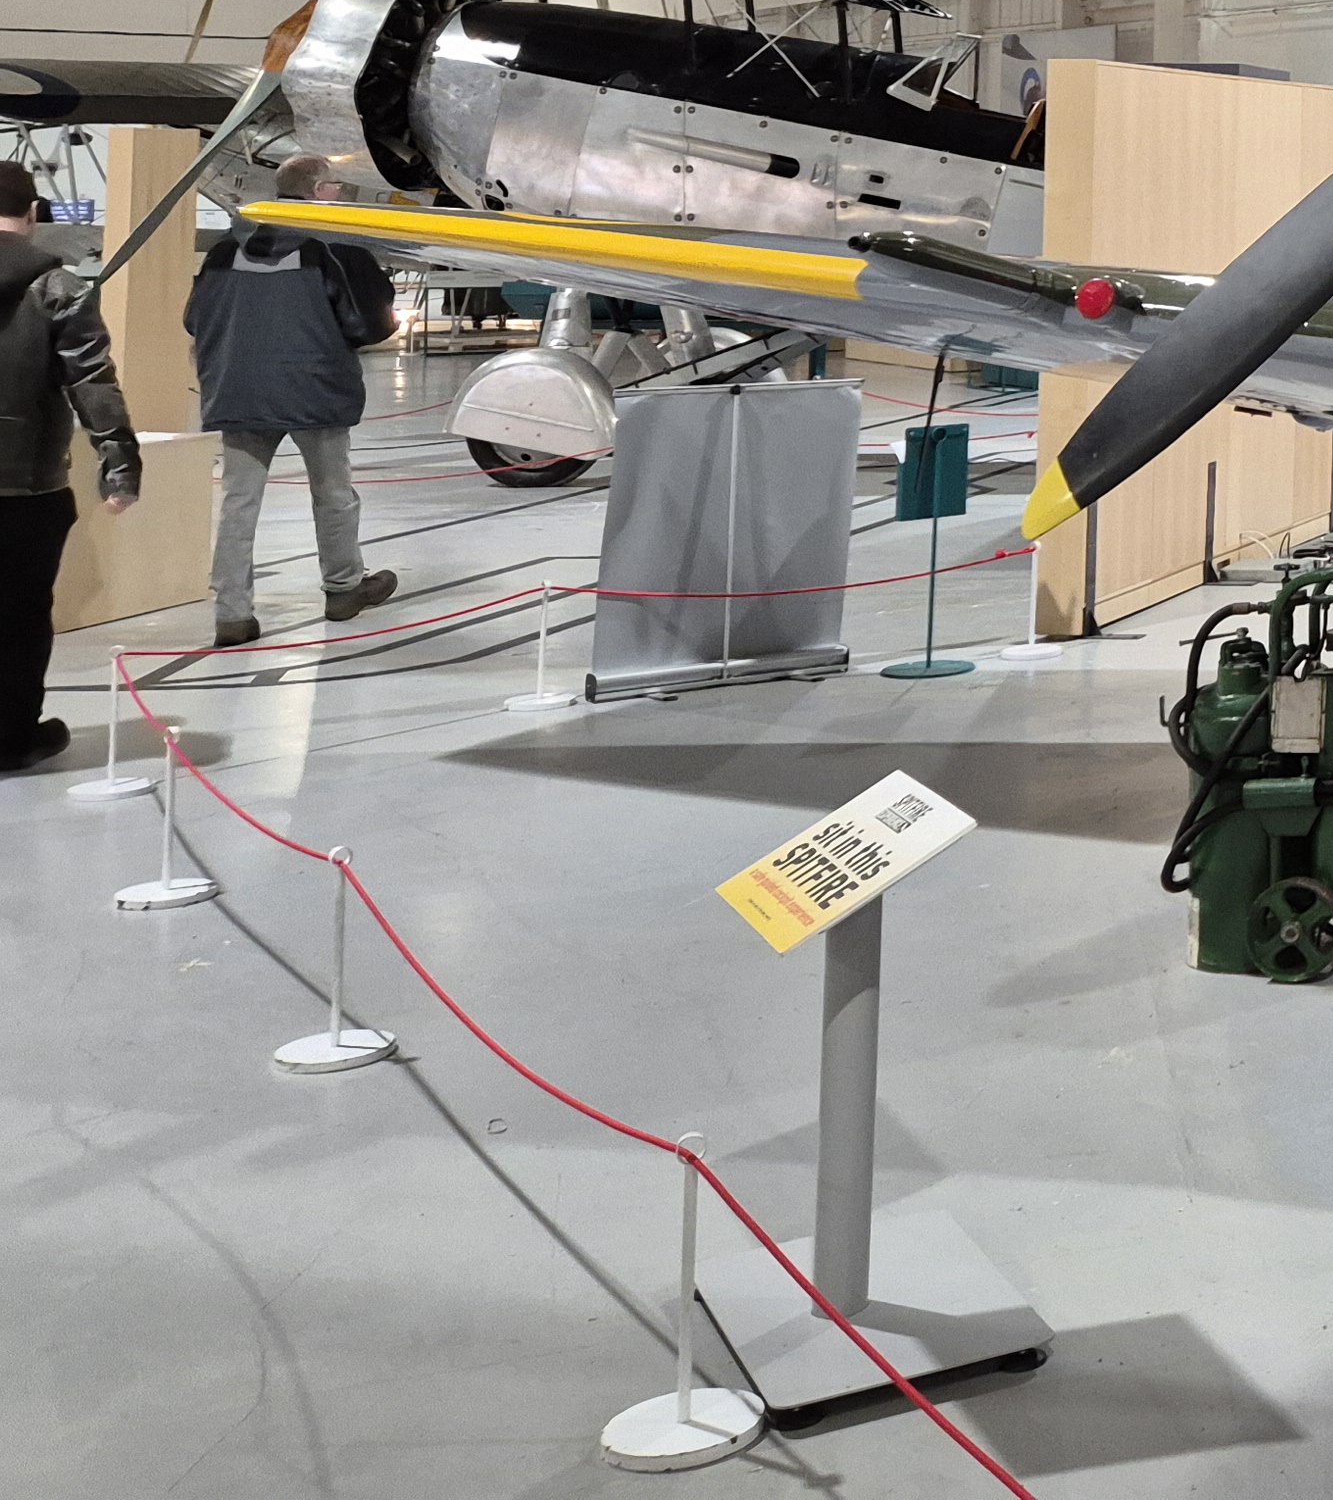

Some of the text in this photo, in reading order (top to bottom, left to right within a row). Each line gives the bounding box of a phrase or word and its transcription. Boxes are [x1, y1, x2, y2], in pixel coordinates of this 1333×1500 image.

[892, 794, 933, 822] SPITFIRE
[772, 843, 859, 910] SPITFIRE
[812, 821, 893, 880] sit in this
